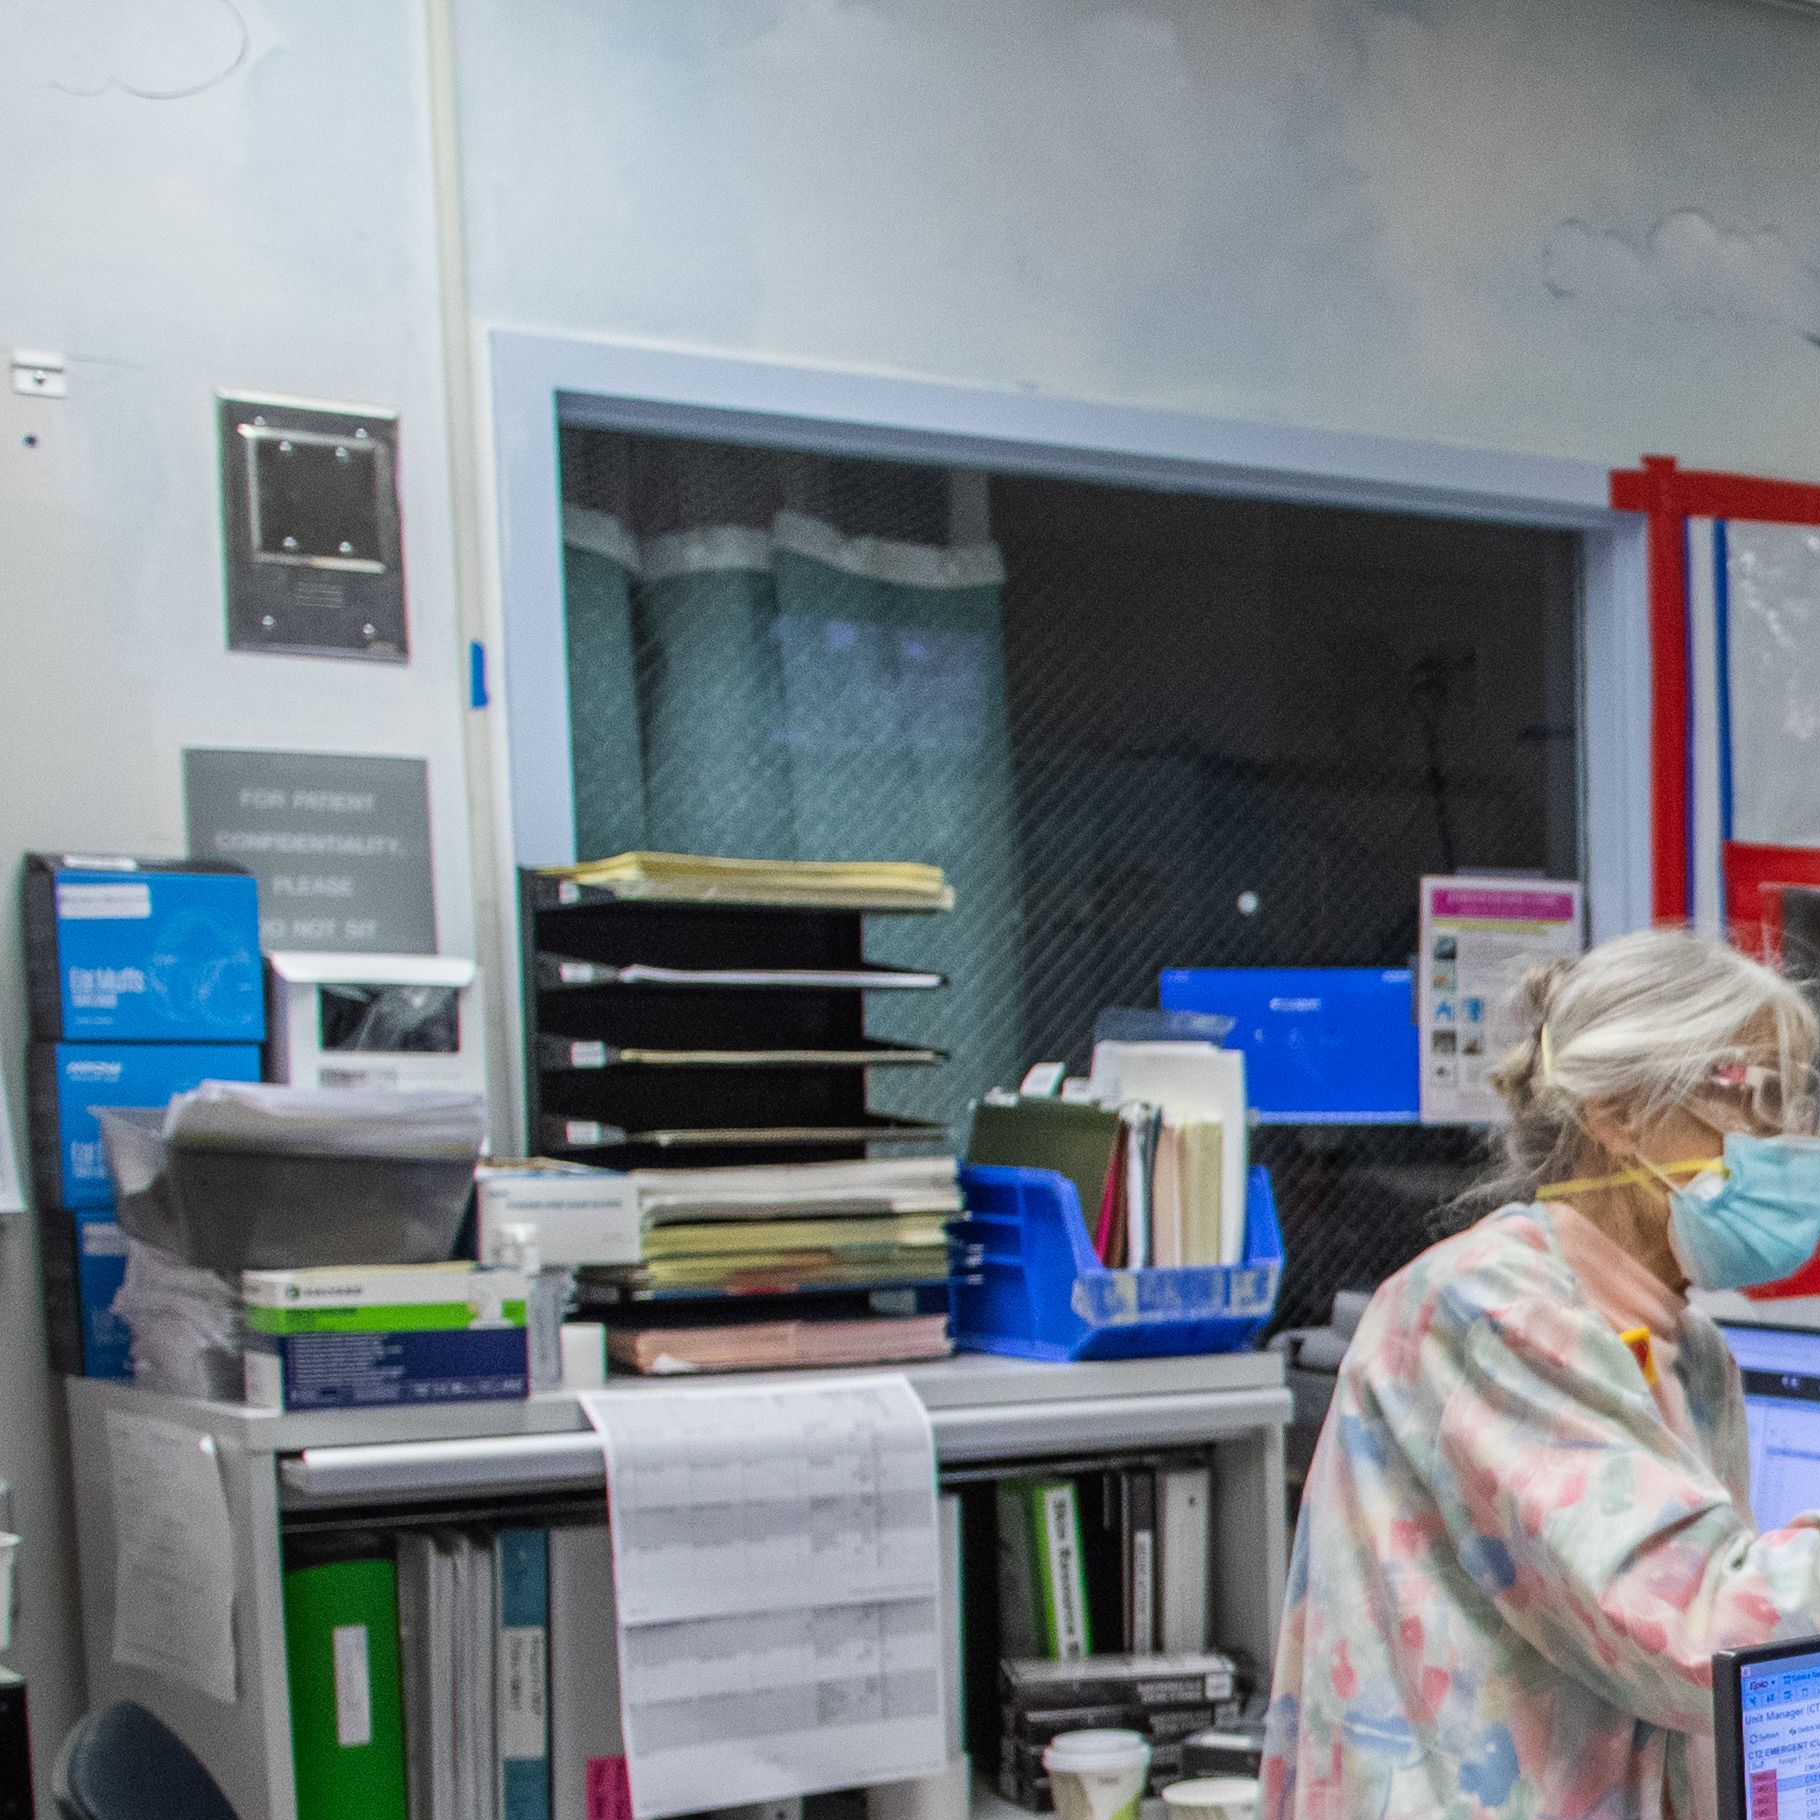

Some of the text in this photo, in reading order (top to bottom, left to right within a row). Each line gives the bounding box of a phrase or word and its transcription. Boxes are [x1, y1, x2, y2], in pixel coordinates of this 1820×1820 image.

[240, 787, 376, 812] FOR PATIENT
[272, 874, 353, 897] PLEASE
[293, 918, 335, 940] NOT
[1766, 1707, 1804, 1722] Manager
